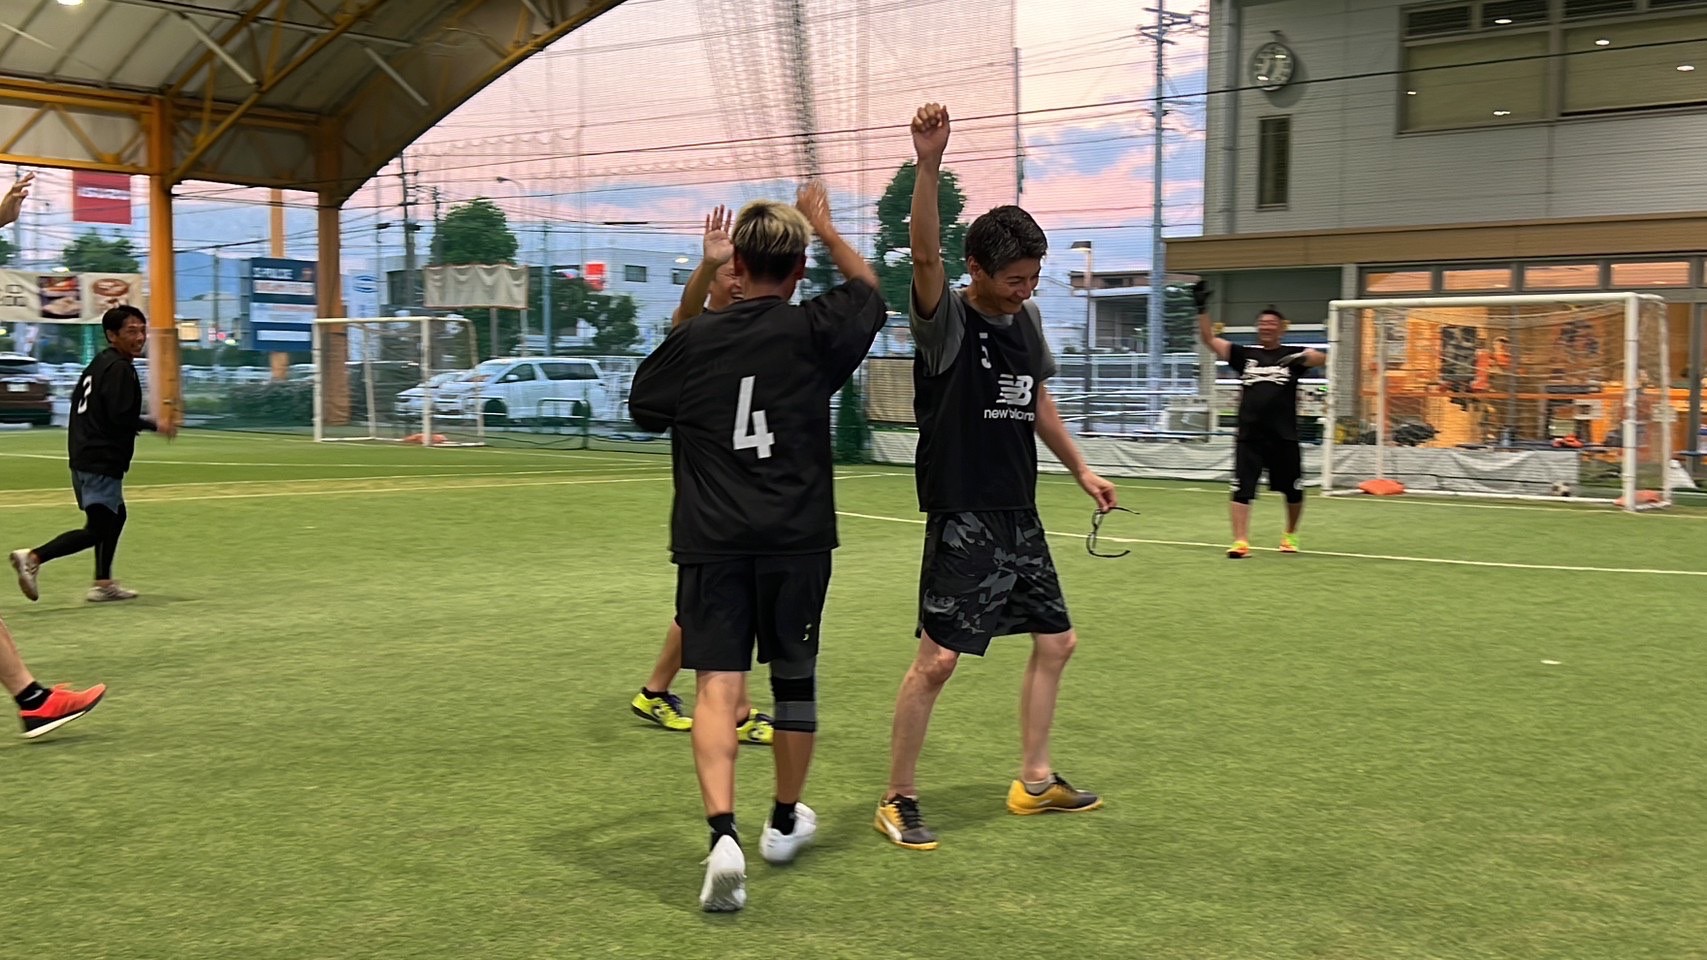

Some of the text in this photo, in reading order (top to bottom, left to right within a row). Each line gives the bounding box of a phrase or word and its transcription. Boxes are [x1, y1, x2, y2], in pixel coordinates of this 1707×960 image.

[77, 375, 93, 414] 3
[984, 408, 1009, 419] new
[733, 375, 775, 459] 4
